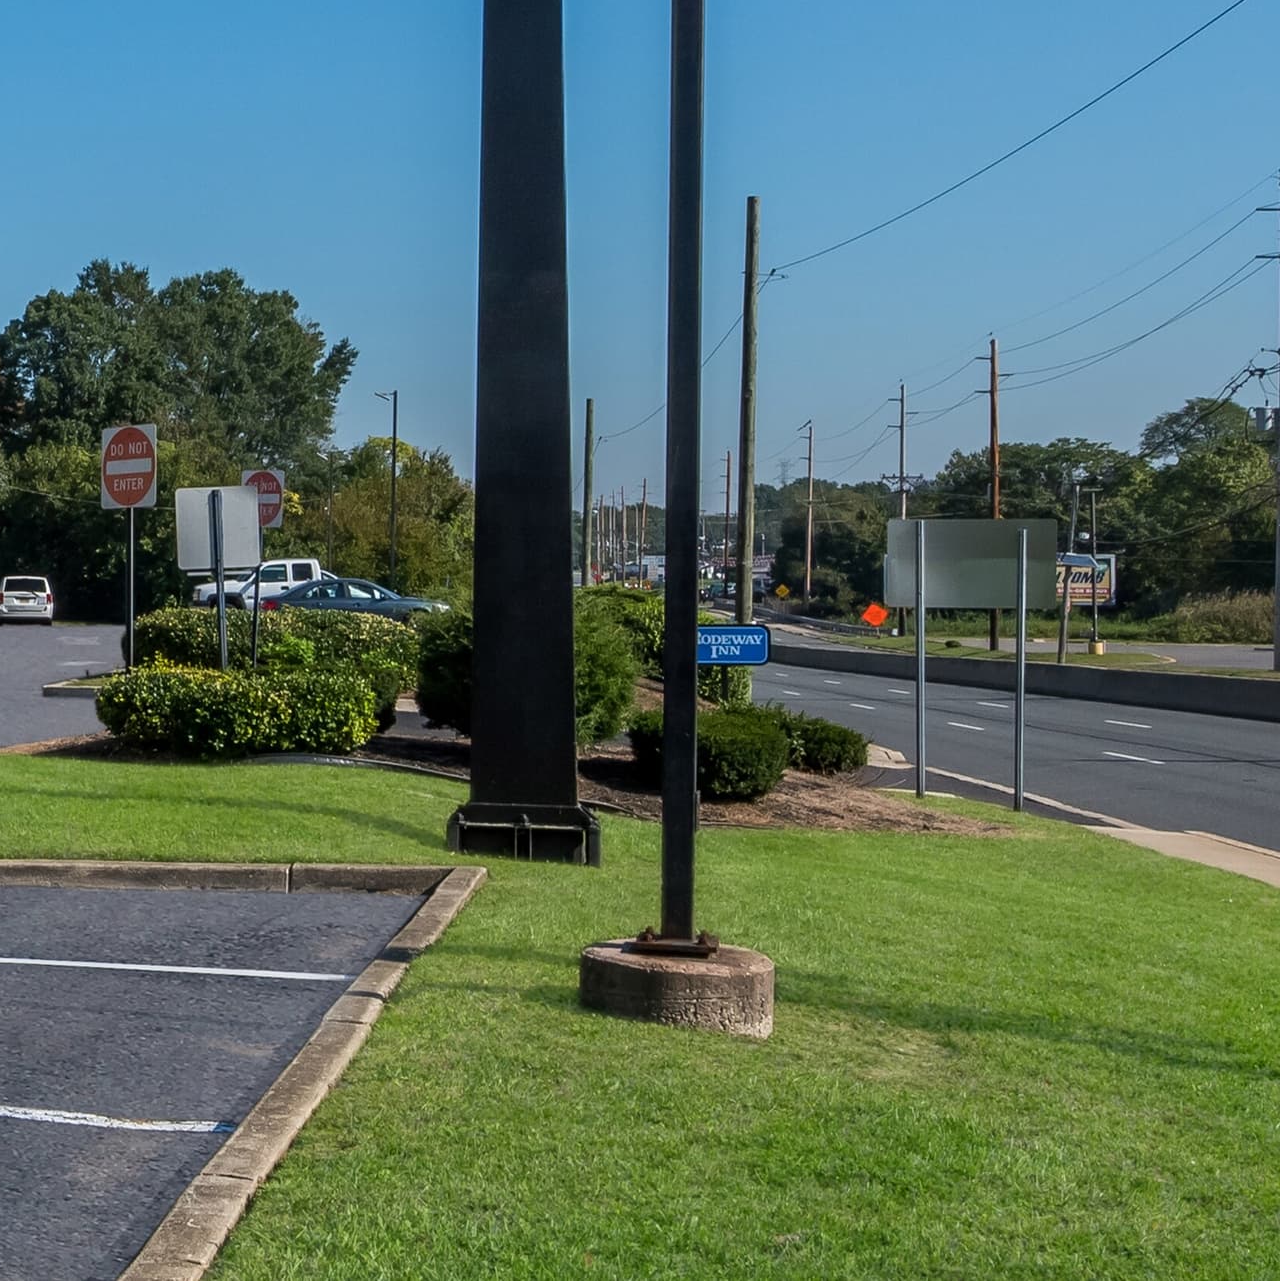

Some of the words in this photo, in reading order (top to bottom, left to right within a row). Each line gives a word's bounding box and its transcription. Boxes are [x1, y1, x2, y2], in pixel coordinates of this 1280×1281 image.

[110, 444, 124, 456] DO
[128, 441, 148, 455] NOT
[113, 477, 144, 492] ENTER
[710, 645, 741, 659] INN
